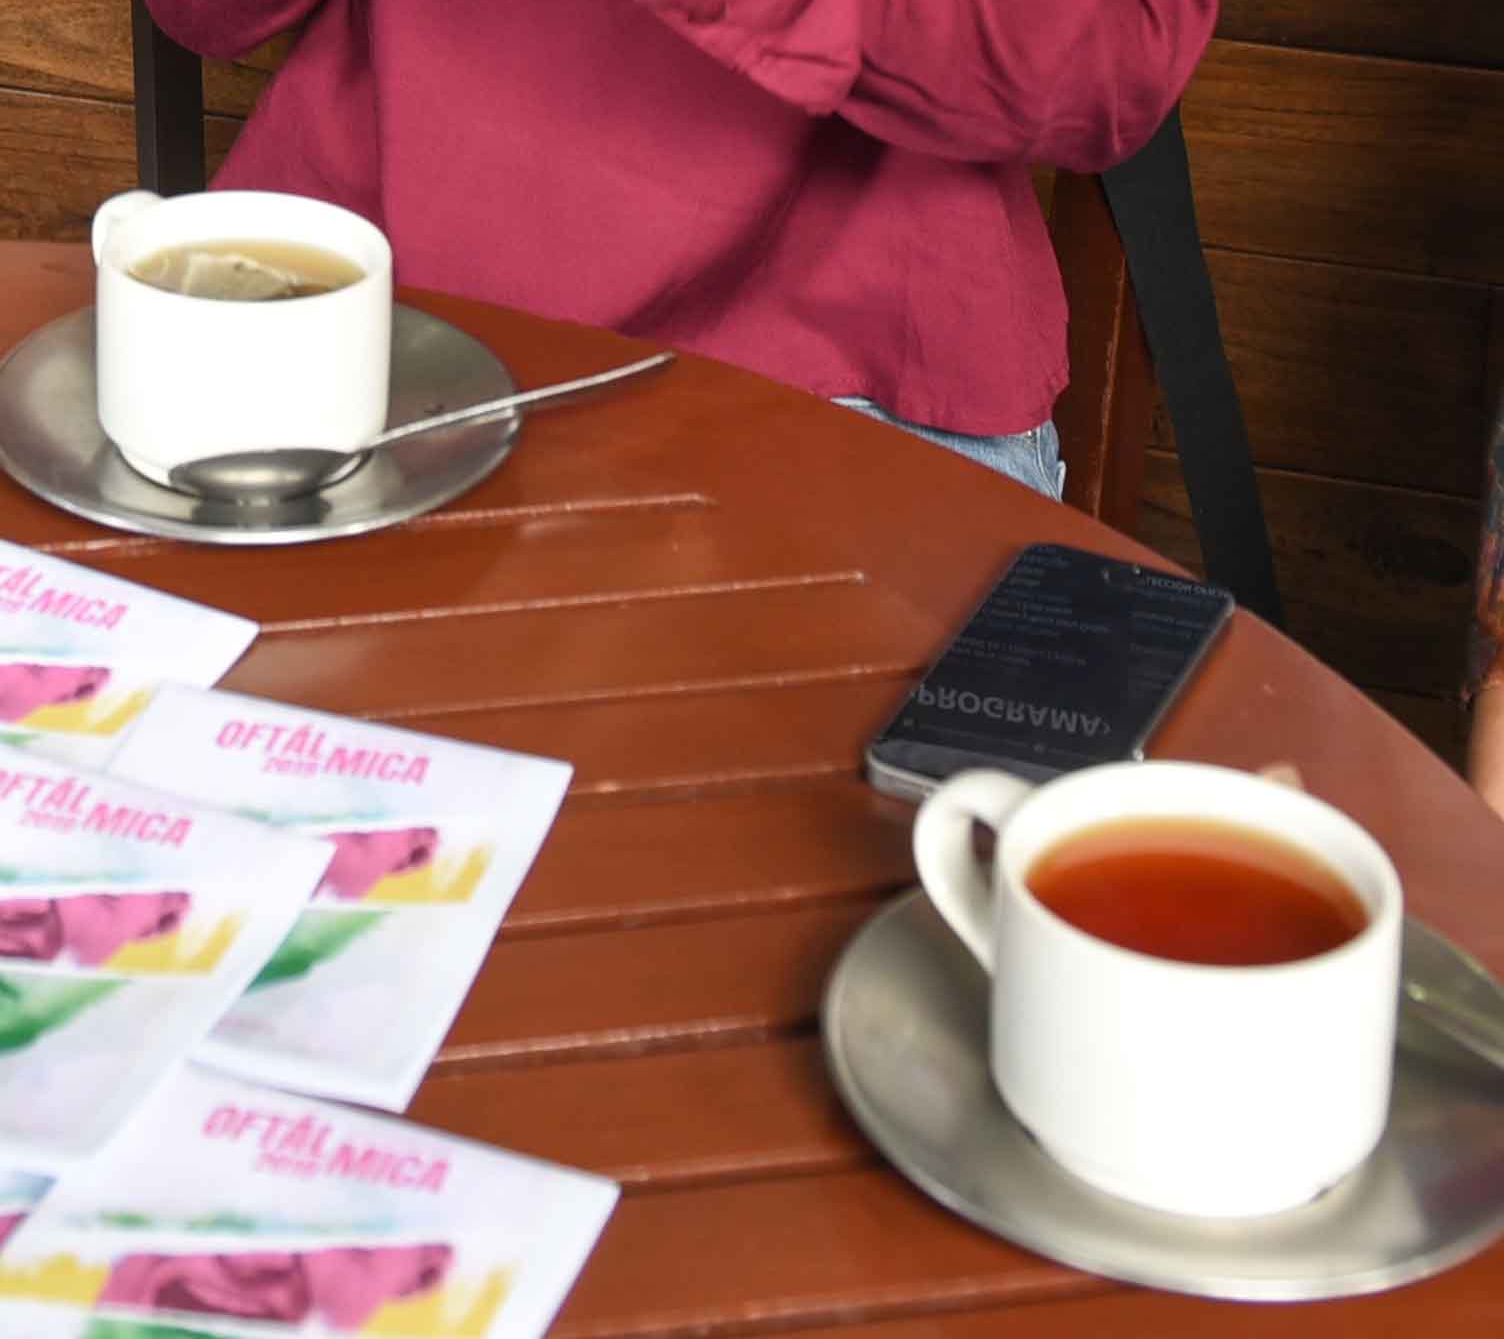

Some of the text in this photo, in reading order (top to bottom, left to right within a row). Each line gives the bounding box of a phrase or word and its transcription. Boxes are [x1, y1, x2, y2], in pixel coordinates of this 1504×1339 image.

[28, 587, 129, 630] MICA
[215, 719, 431, 786] OFTÁL MICA
[80, 801, 193, 848] MICA
